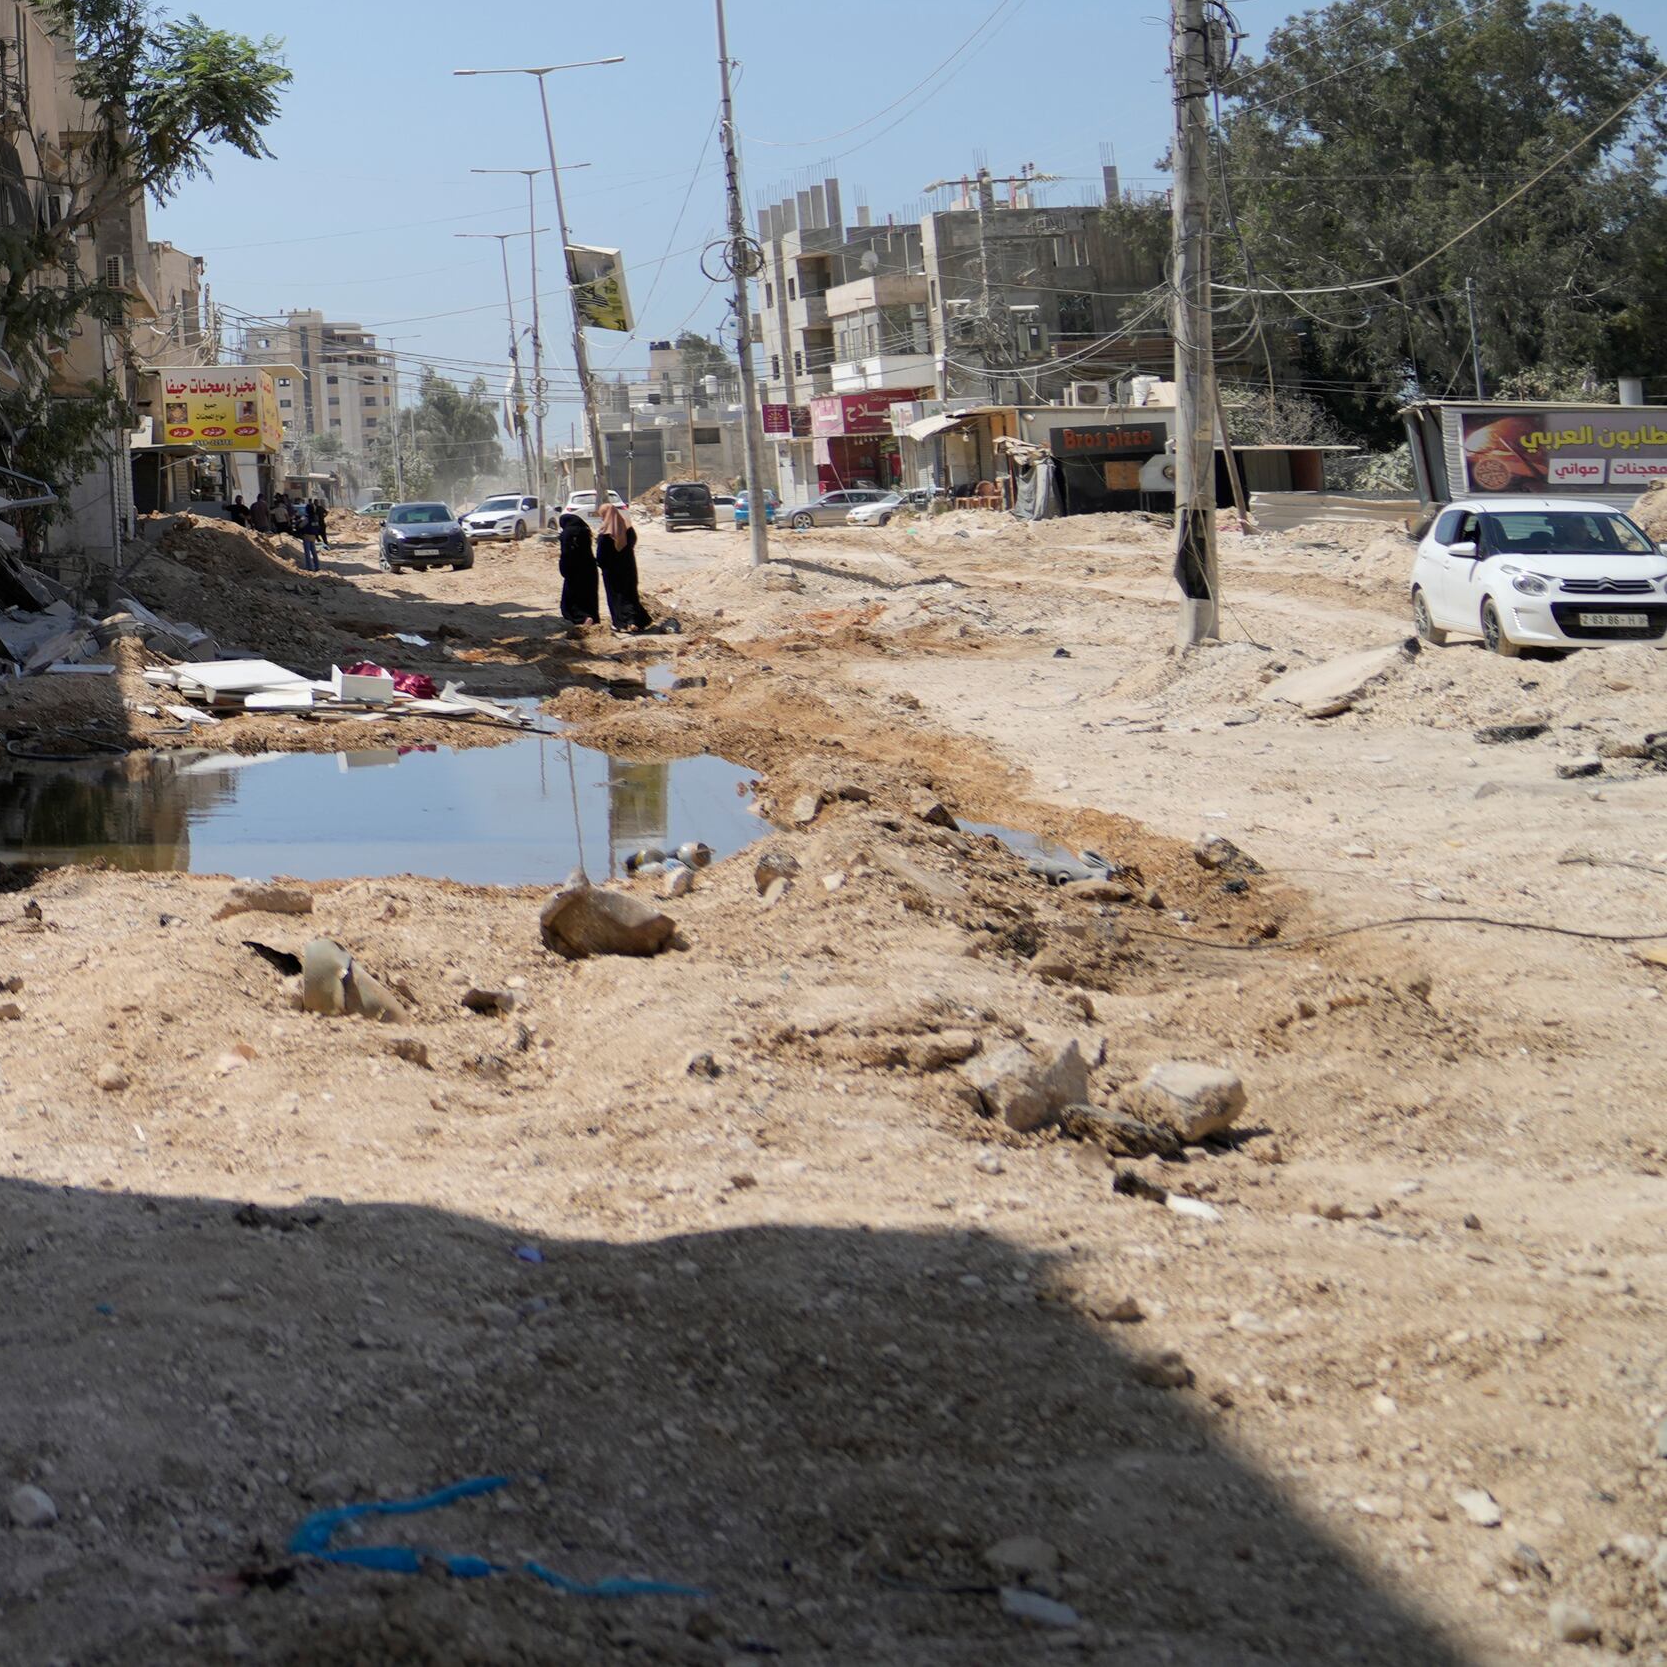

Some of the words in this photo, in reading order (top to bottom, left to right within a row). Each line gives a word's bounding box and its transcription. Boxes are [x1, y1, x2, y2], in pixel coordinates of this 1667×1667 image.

[166, 378, 188, 399] حيفا
[233, 376, 257, 397] مخبز
[1063, 428, 1102, 449] Bros
[1106, 429, 1152, 451] pizza
[1520, 425, 1594, 454] العربي
[1555, 462, 1600, 480] صواني
